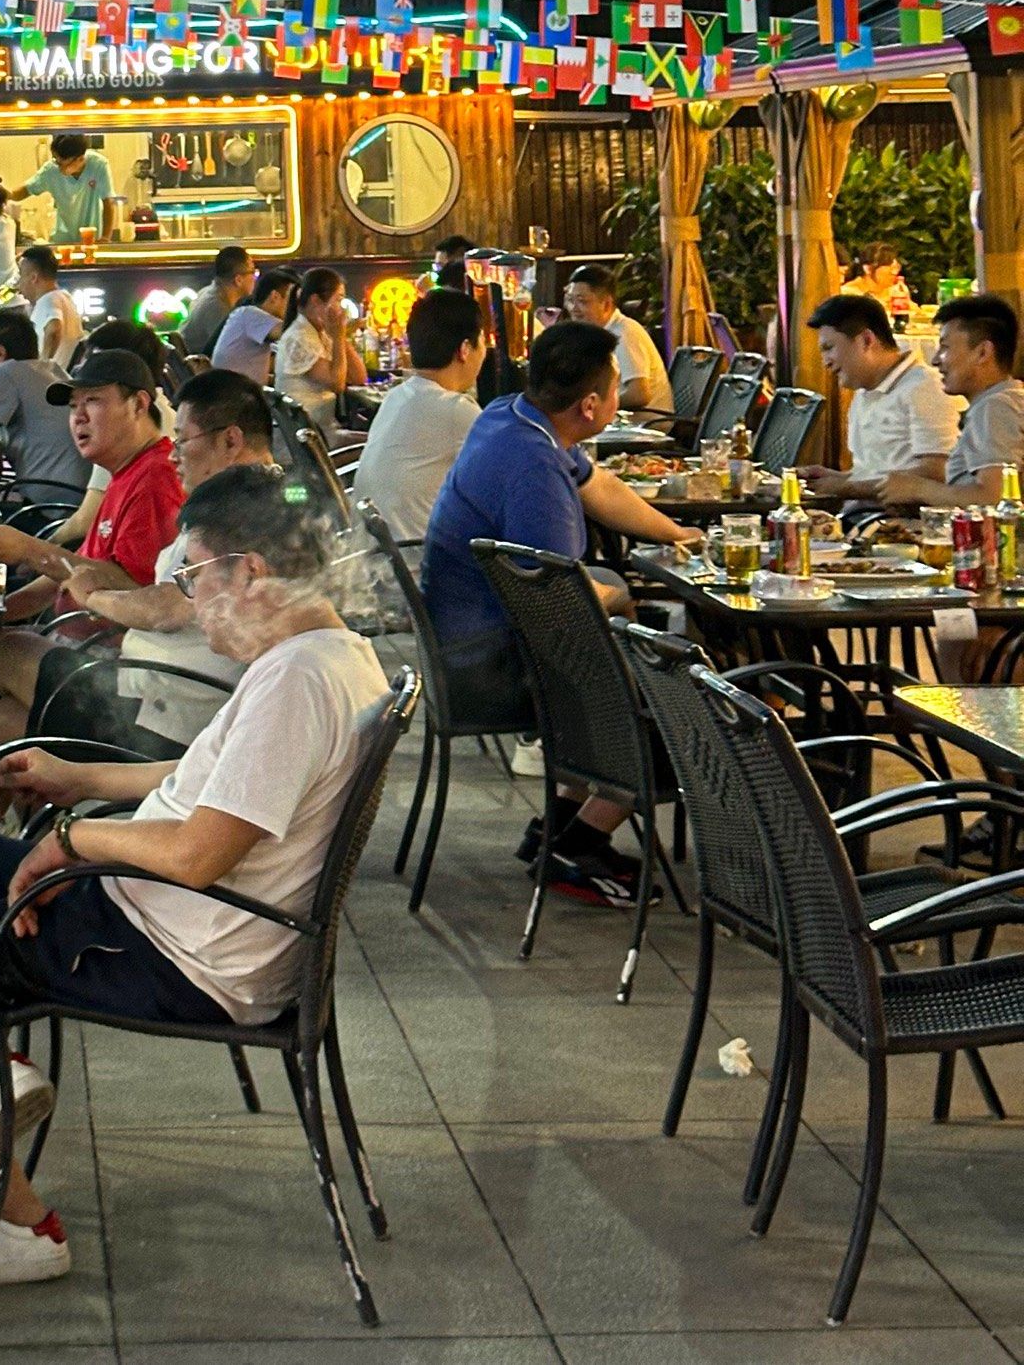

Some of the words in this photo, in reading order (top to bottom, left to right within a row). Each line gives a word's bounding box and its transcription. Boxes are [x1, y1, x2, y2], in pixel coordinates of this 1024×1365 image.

[13, 42, 174, 77] WAITING
[182, 39, 261, 74] FOR
[4, 74, 52, 92] FRESH
[56, 73, 106, 91] BAKED
[109, 71, 165, 90] GOODS
